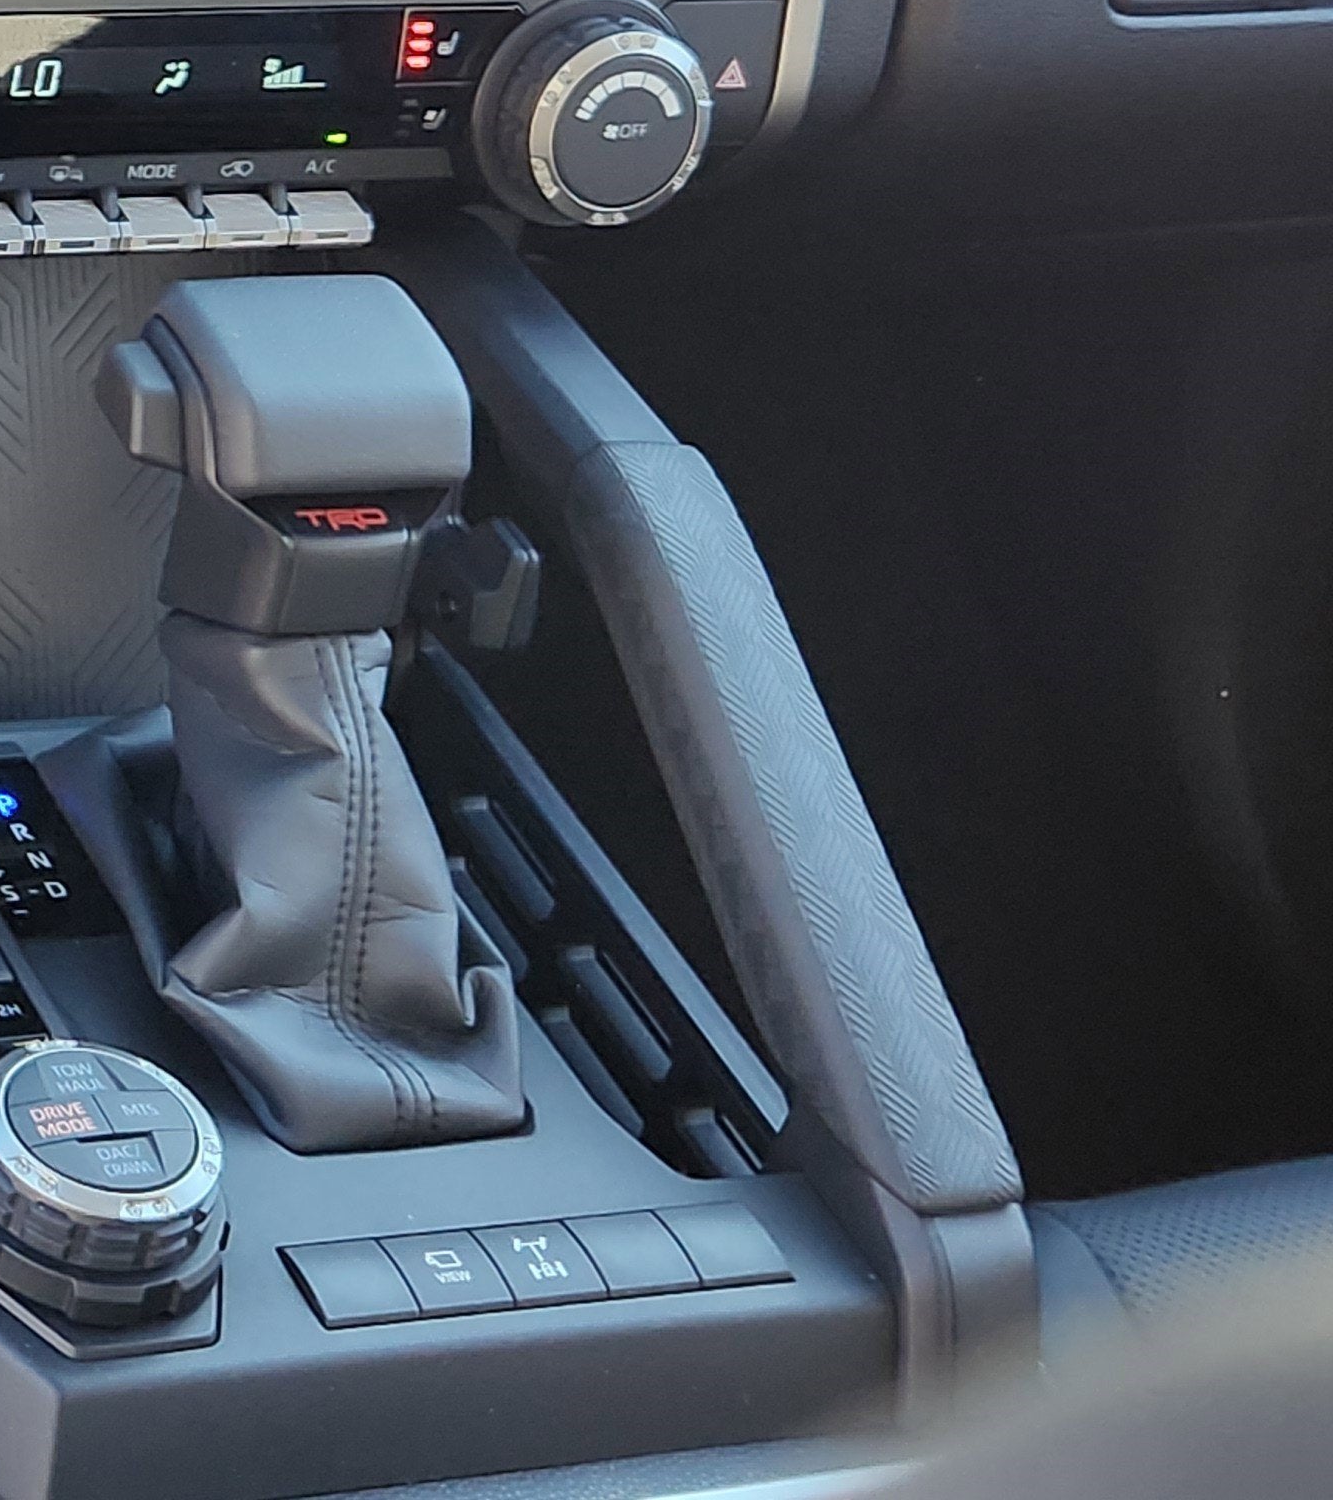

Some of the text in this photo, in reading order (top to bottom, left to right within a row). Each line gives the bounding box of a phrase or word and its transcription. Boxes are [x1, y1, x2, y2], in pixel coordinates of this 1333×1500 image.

[8, 58, 63, 99] LO
[619, 123, 648, 139] OFF
[127, 163, 177, 180] MODE
[305, 158, 337, 175] A/C
[293, 506, 389, 531] TRD
[9, 822, 35, 843] R
[26, 850, 52, 870] N
[0, 881, 68, 902] S D
[51, 1063, 95, 1079] TOW
[56, 1076, 109, 1094] HAUL
[29, 1101, 88, 1123] DRIVE
[36, 1116, 97, 1139] MODE
[96, 1143, 142, 1162] DAC/
[102, 1160, 156, 1178] CRAWL
[433, 1268, 472, 1284] VIEW
